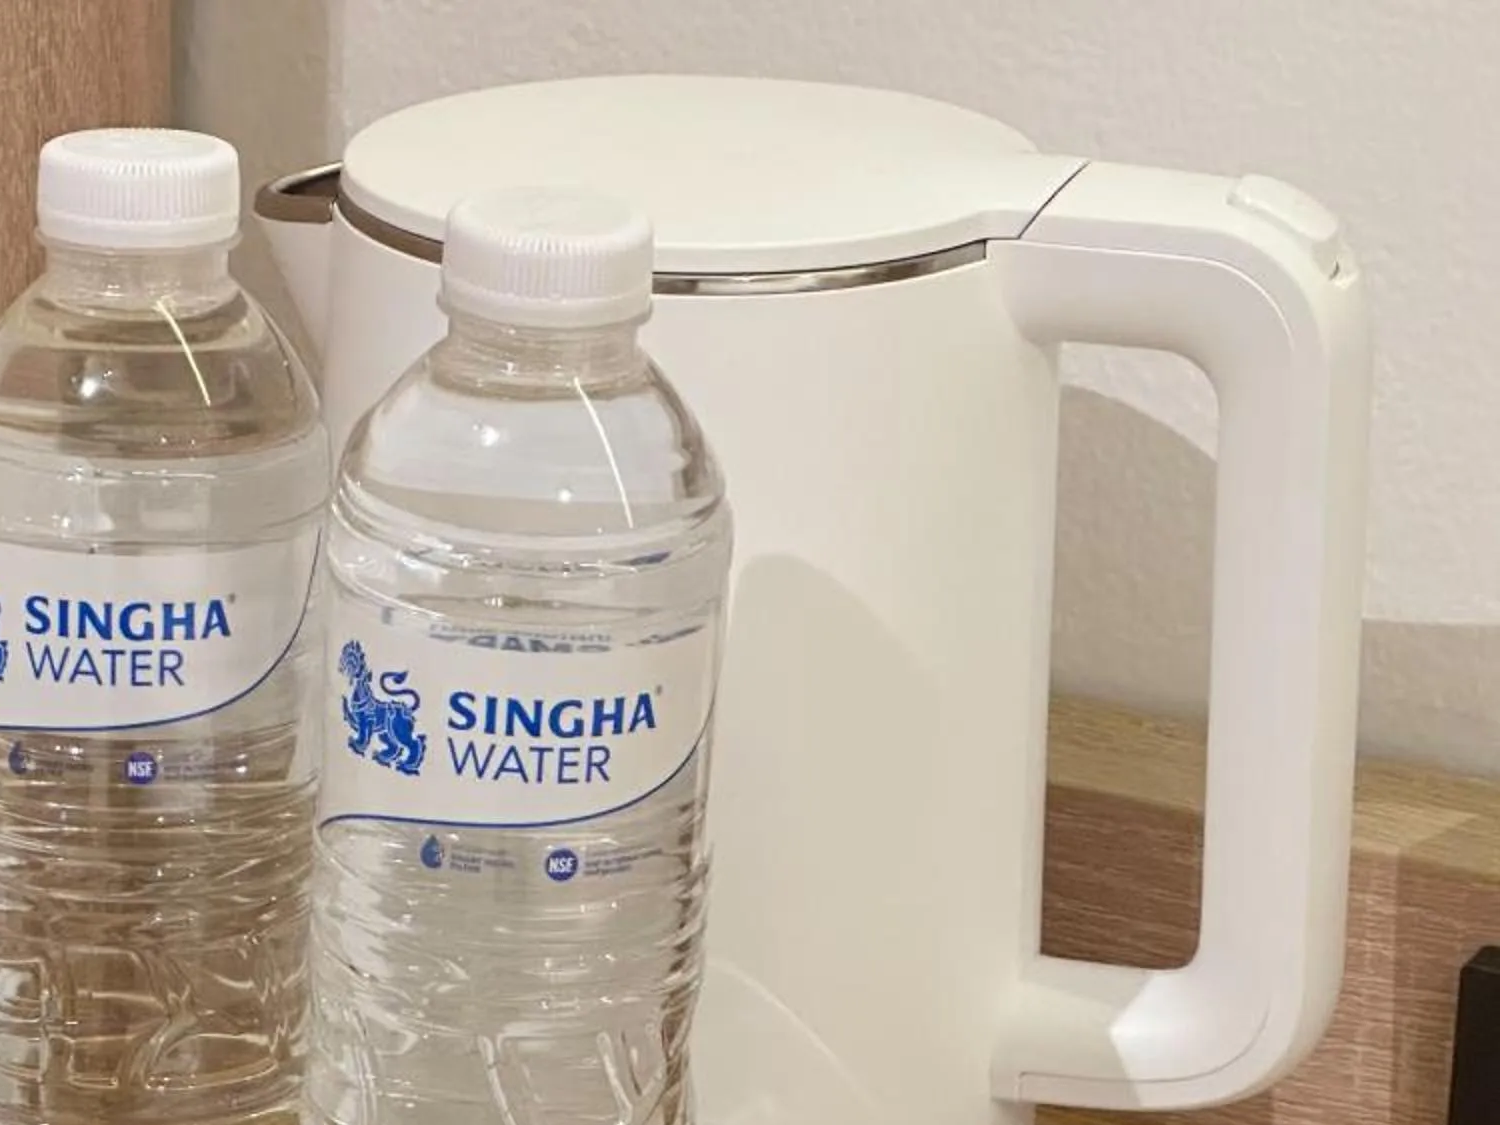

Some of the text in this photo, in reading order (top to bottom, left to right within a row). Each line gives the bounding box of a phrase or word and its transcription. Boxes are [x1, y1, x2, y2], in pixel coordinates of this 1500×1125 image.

[24, 595, 232, 642] SINGHA
[25, 641, 185, 687] WATER
[447, 690, 657, 739] SINGHA
[127, 761, 154, 778] NSF
[447, 736, 612, 785] WATER
[548, 856, 577, 874] NSF
